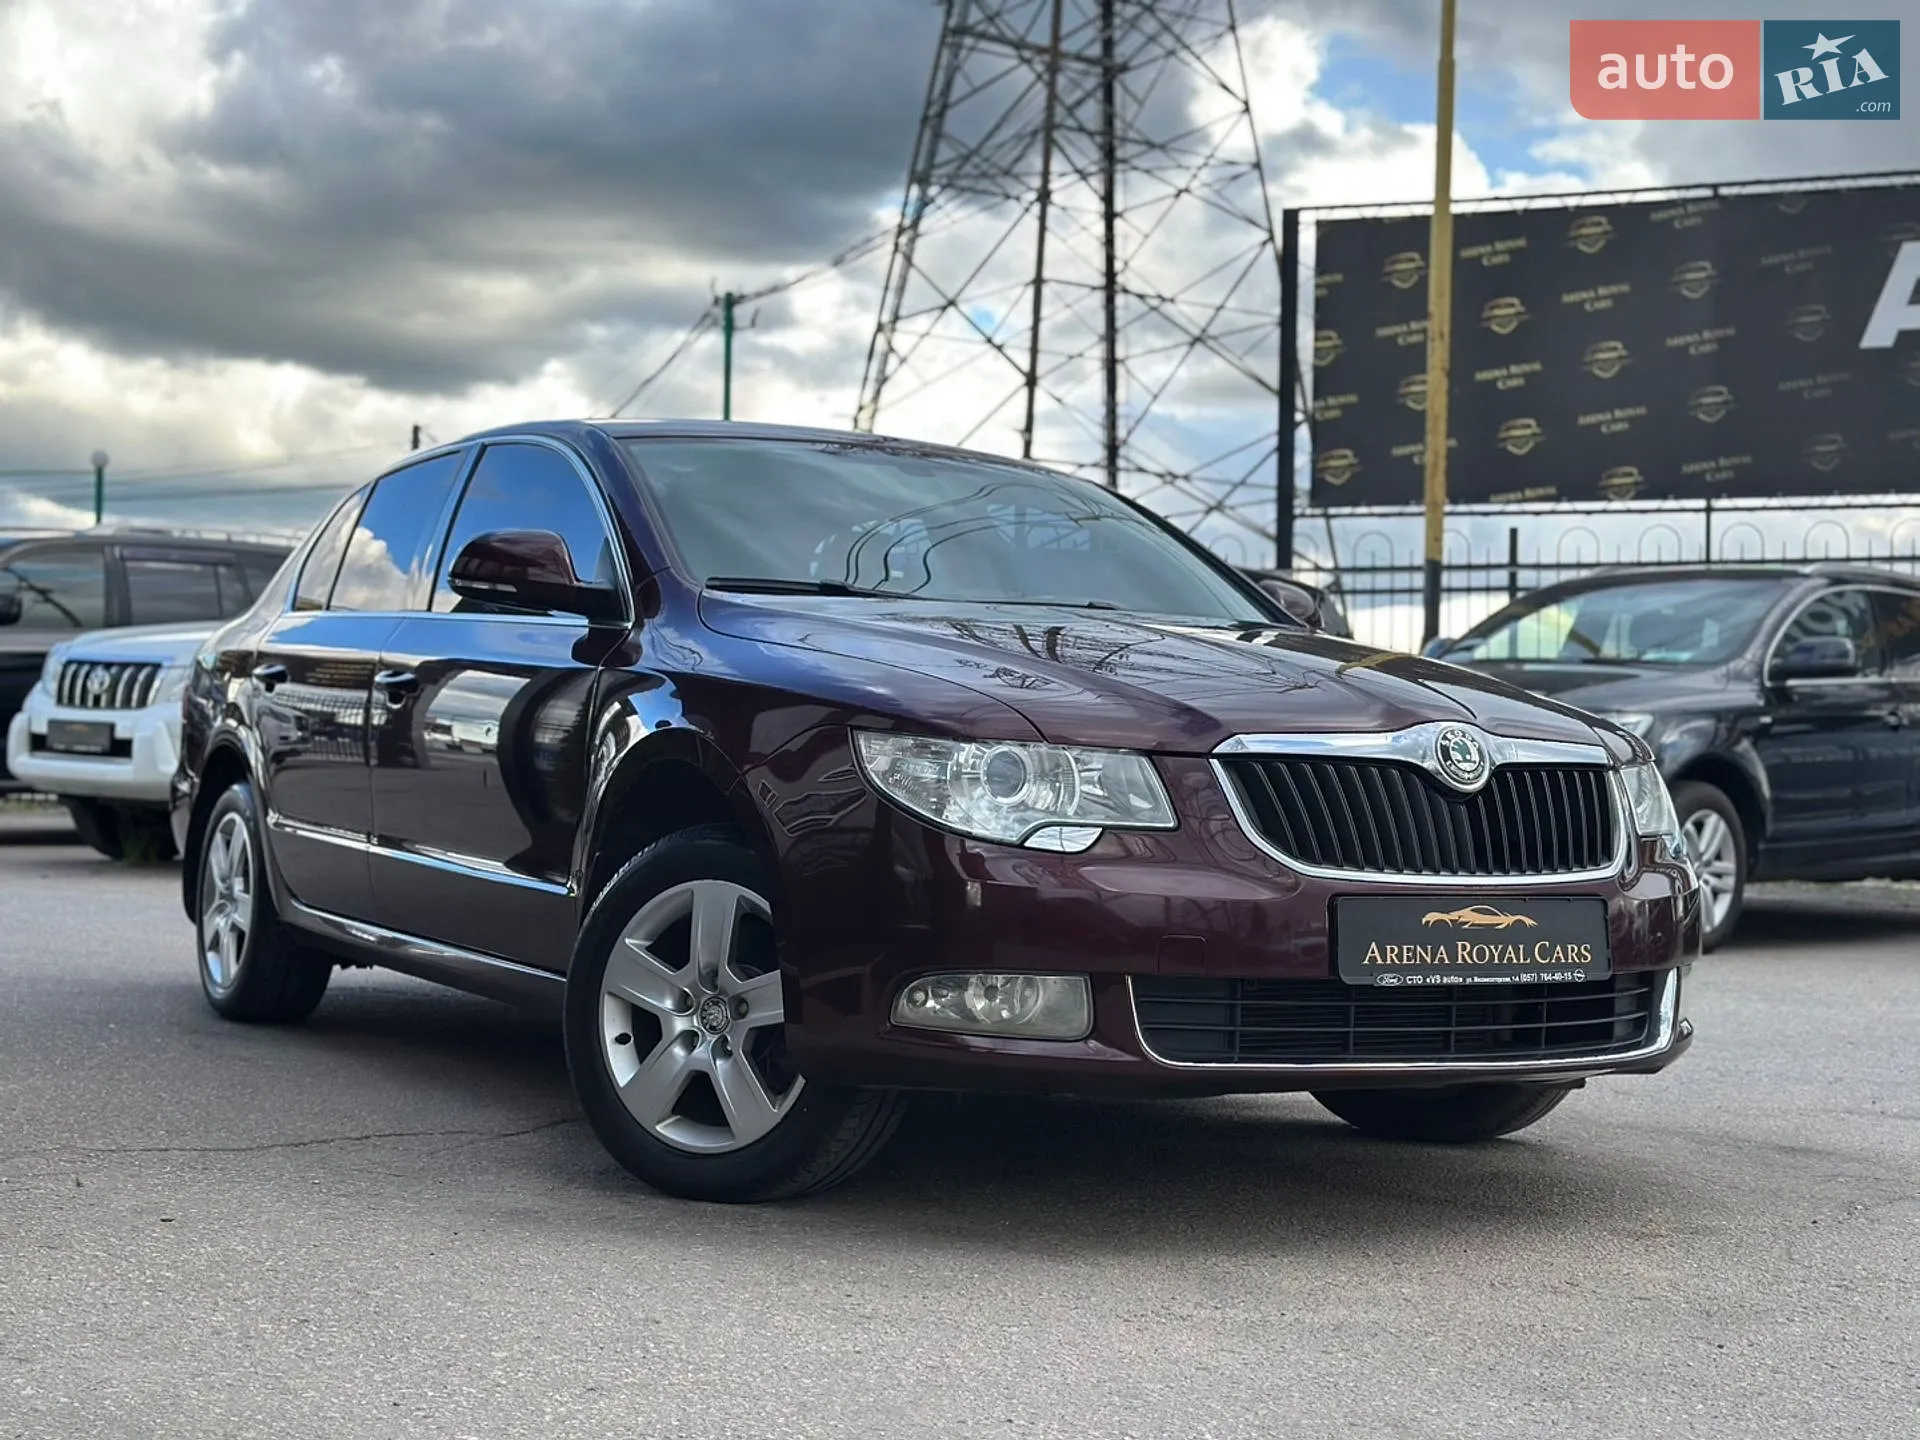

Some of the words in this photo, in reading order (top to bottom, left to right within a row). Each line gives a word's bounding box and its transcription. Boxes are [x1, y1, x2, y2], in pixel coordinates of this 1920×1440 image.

[1362, 941, 1450, 964] ARENA
[1456, 941, 1530, 964] ROYAL
[1534, 941, 1592, 963] CARS
